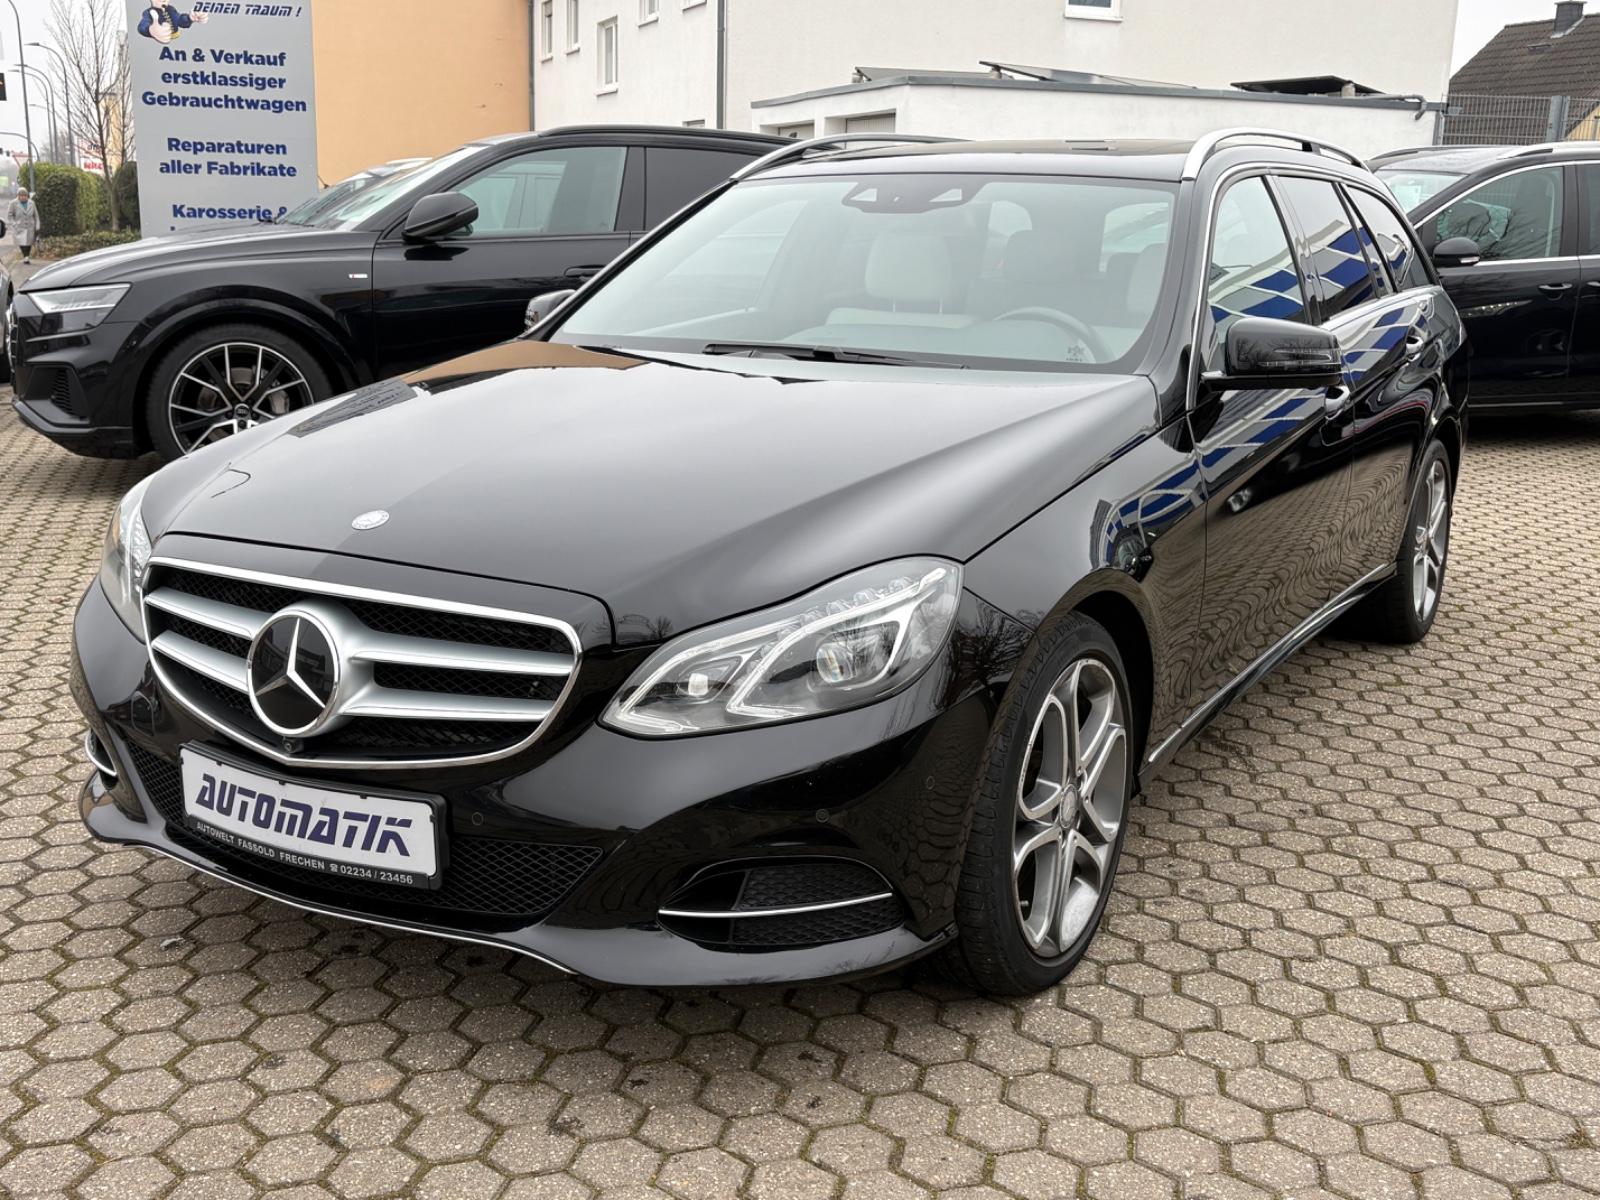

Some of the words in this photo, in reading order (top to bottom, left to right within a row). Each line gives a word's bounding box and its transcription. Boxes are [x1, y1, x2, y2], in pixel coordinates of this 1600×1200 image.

[193, 1, 240, 15] DEINEN
[245, 4, 293, 17] TRAUM
[296, 6, 302, 18] !
[159, 47, 187, 62] An
[192, 49, 206, 63] &
[210, 49, 287, 67] Verkauf
[161, 71, 287, 90] erstklassiger
[142, 91, 307, 114] Gebrauchtwagen
[167, 137, 288, 156] Reparaturen
[159, 160, 202, 175] aller
[207, 161, 298, 178] Fabrikate
[172, 204, 272, 219] Karosserie
[196, 773, 413, 857] AUTOMATIK
[196, 822, 235, 844] AUTOWELT
[237, 836, 276, 857] FASSOLD
[280, 852, 326, 870] FRECHEN
[340, 864, 373, 879] 02234
[380, 871, 414, 885] 23456
